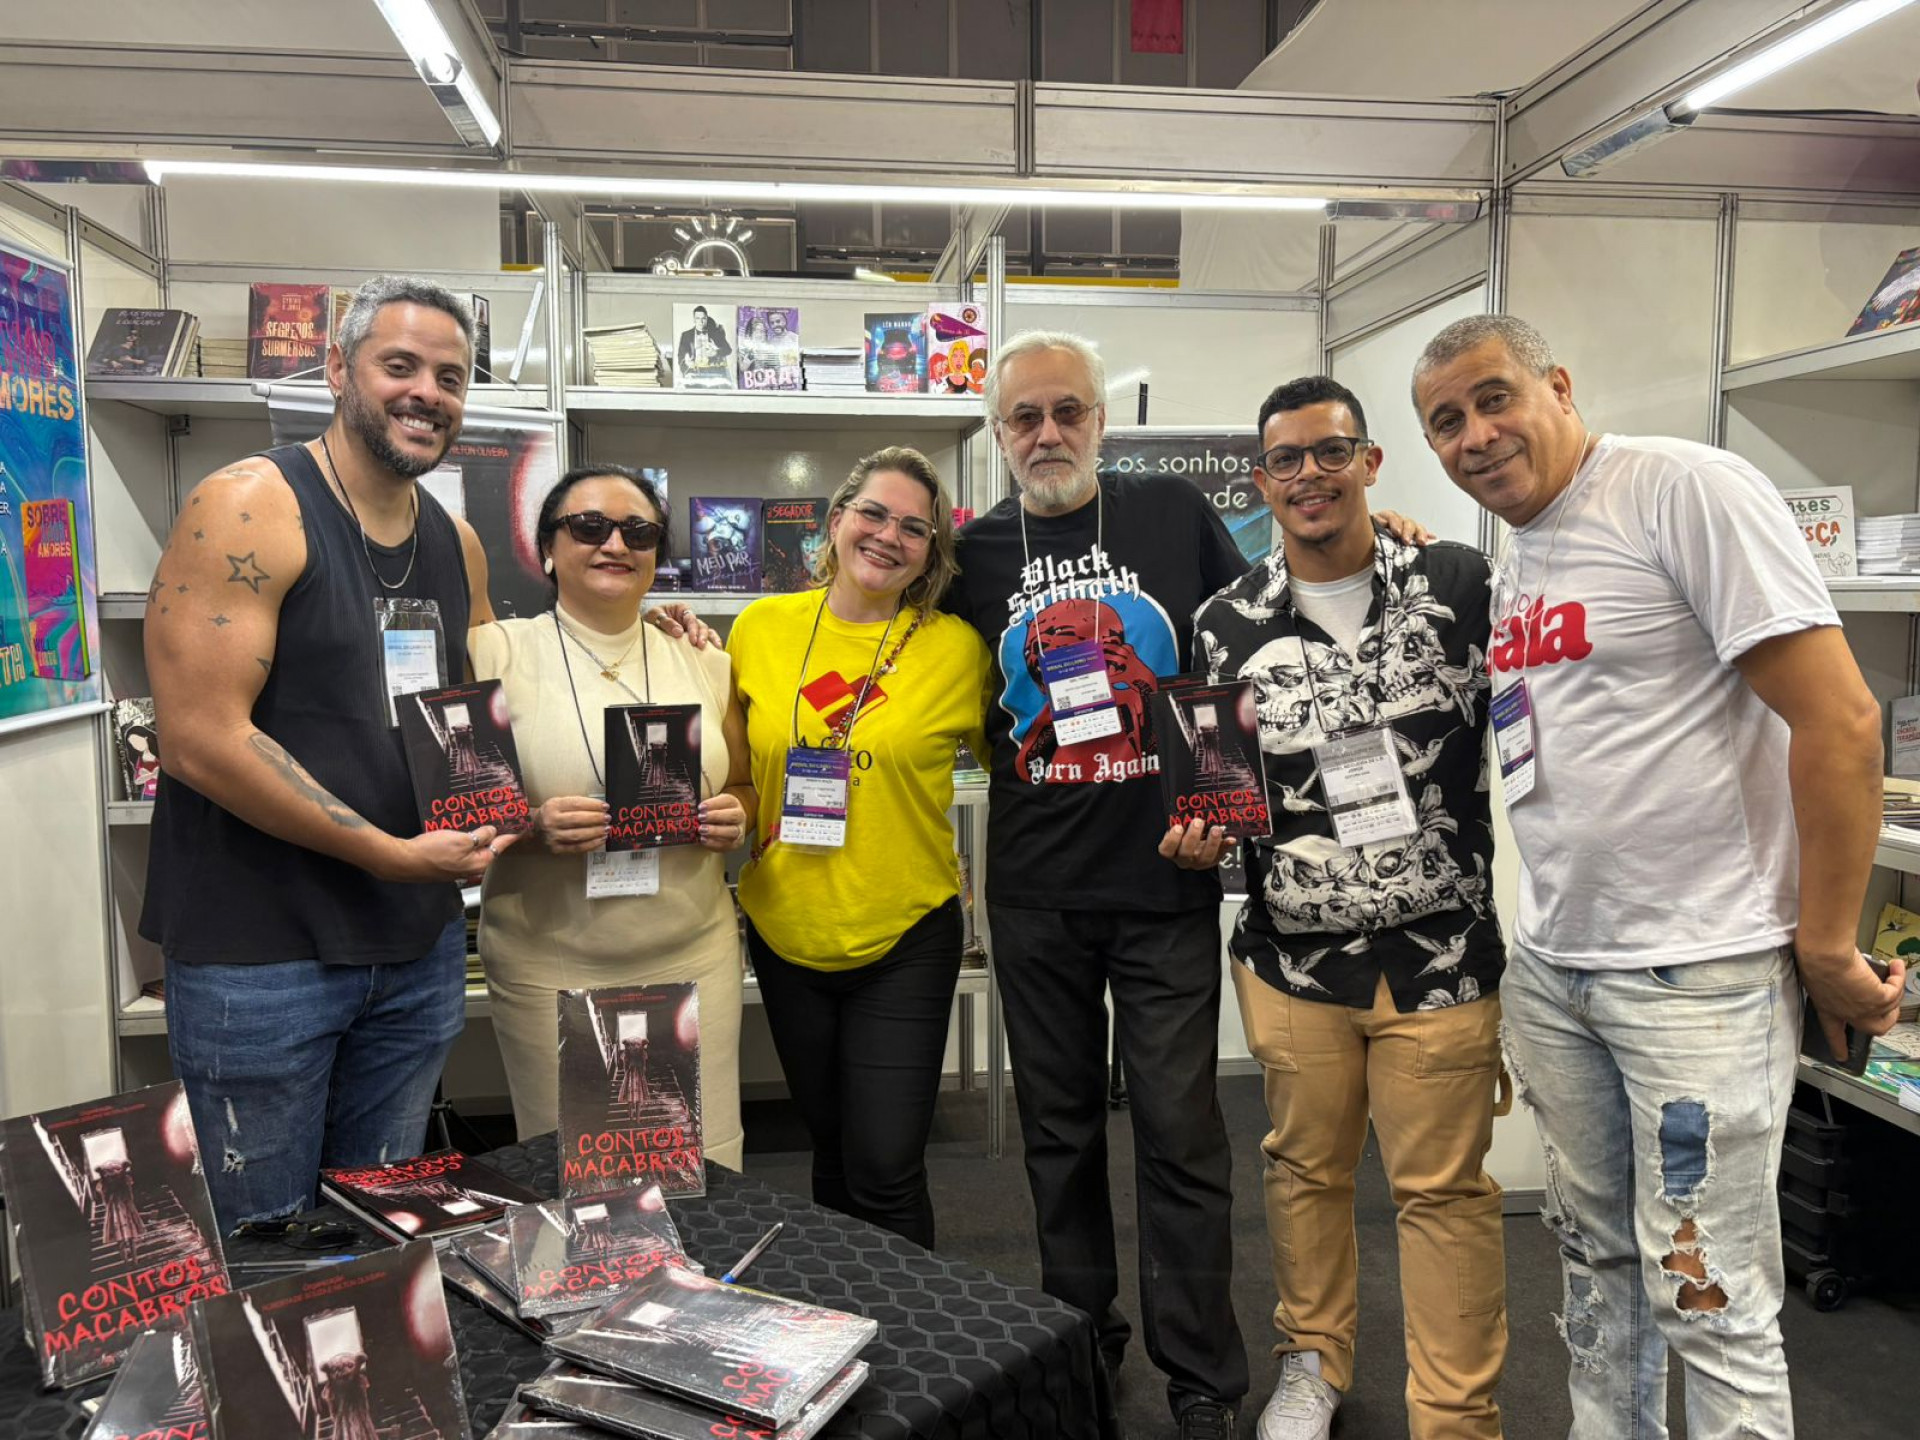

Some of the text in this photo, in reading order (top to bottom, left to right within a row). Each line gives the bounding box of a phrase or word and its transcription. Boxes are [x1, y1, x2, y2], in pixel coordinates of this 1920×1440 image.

[1115, 456, 1147, 474] os
[1158, 449, 1251, 474] sonhos
[1020, 543, 1113, 594] Black
[1006, 565, 1139, 626] Sabbath
[1028, 751, 1161, 785] Born Again
[424, 798, 529, 833] MACABROS
[431, 785, 515, 816] CONTOS
[618, 802, 692, 824] CONTOS
[1176, 789, 1255, 812] CONTOS
[609, 815, 700, 839] MACABROS
[578, 1127, 685, 1157] CONTOS
[564, 1147, 700, 1182] MACABROS
[539, 1250, 664, 1284] CONTOS
[58, 1255, 203, 1321] CONTOS
